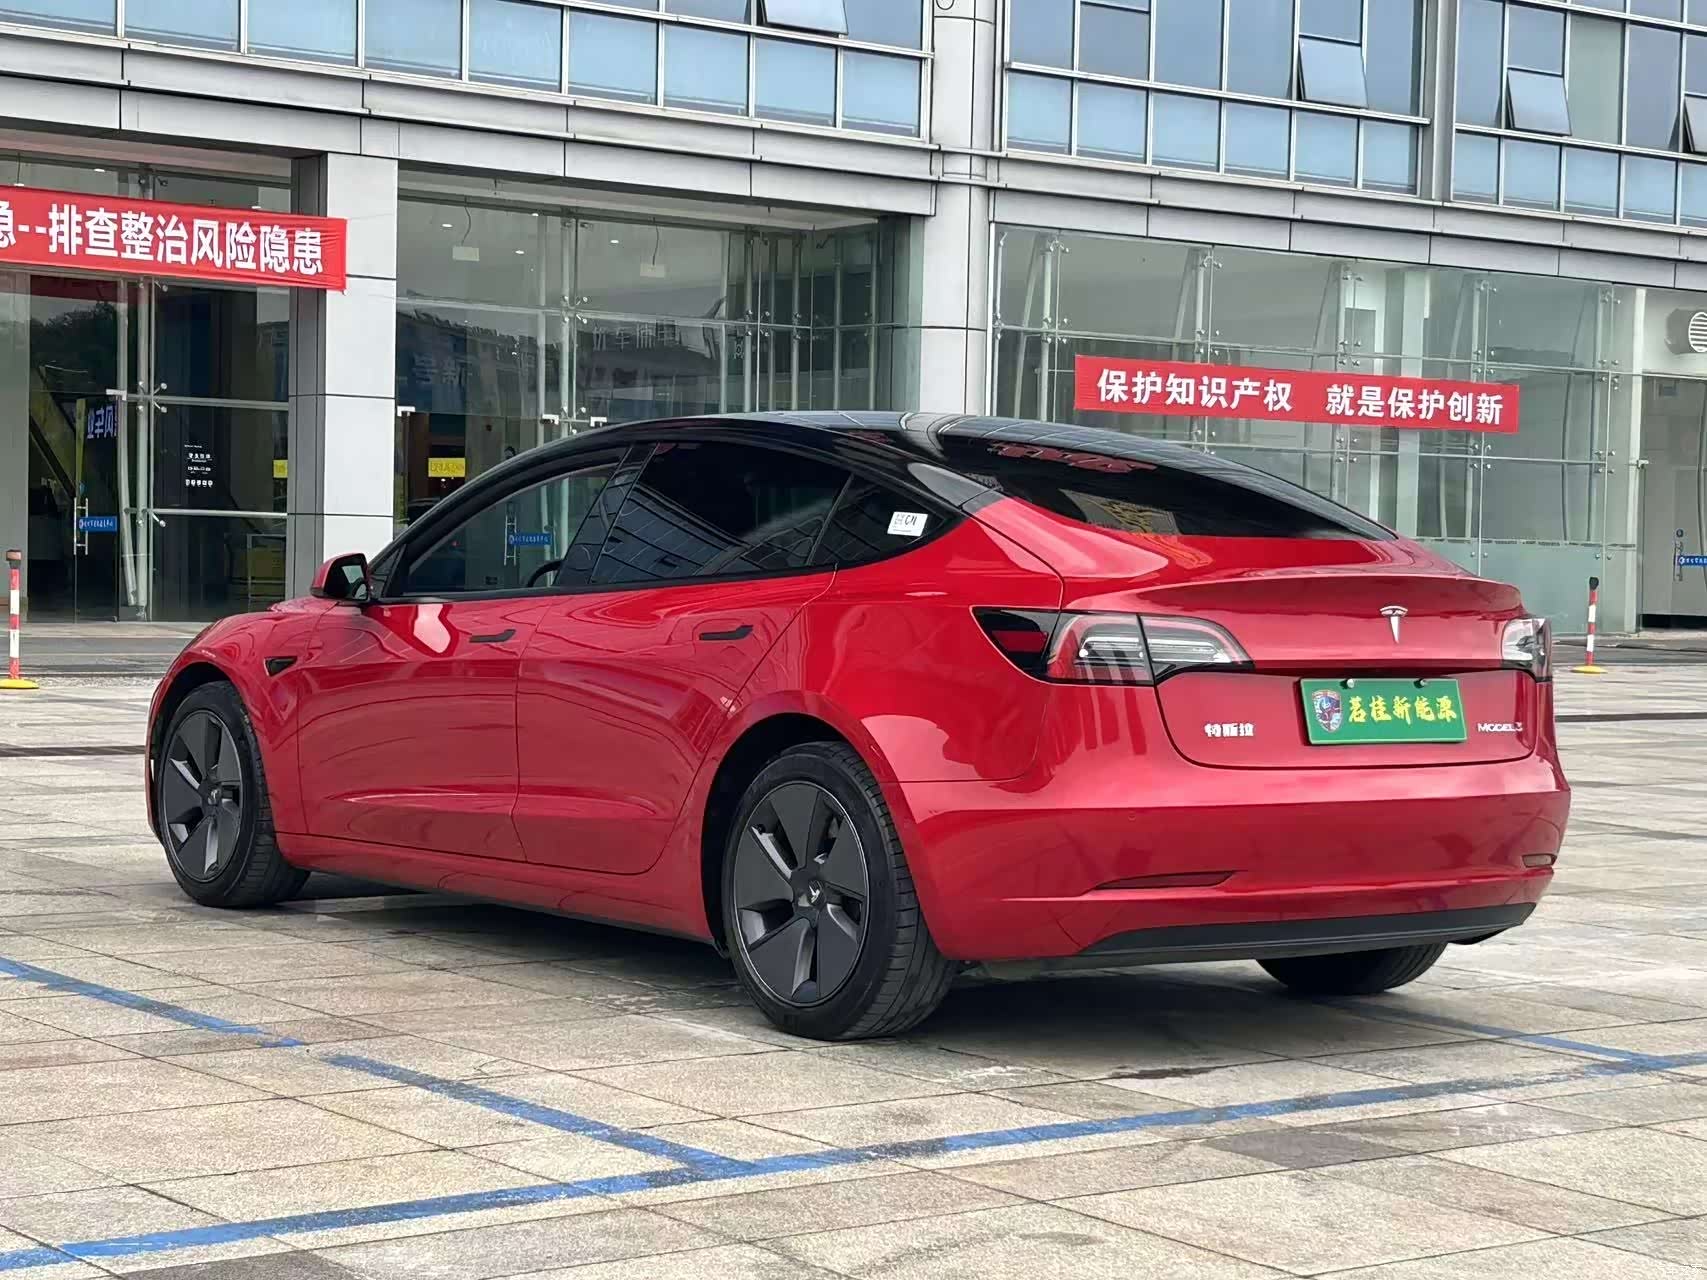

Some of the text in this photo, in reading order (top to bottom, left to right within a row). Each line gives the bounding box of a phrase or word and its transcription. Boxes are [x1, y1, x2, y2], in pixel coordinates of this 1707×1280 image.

[1097, 368, 1504, 425] 保护知识产权 就是保护创新
[1204, 722, 1254, 737] 特斯拉
